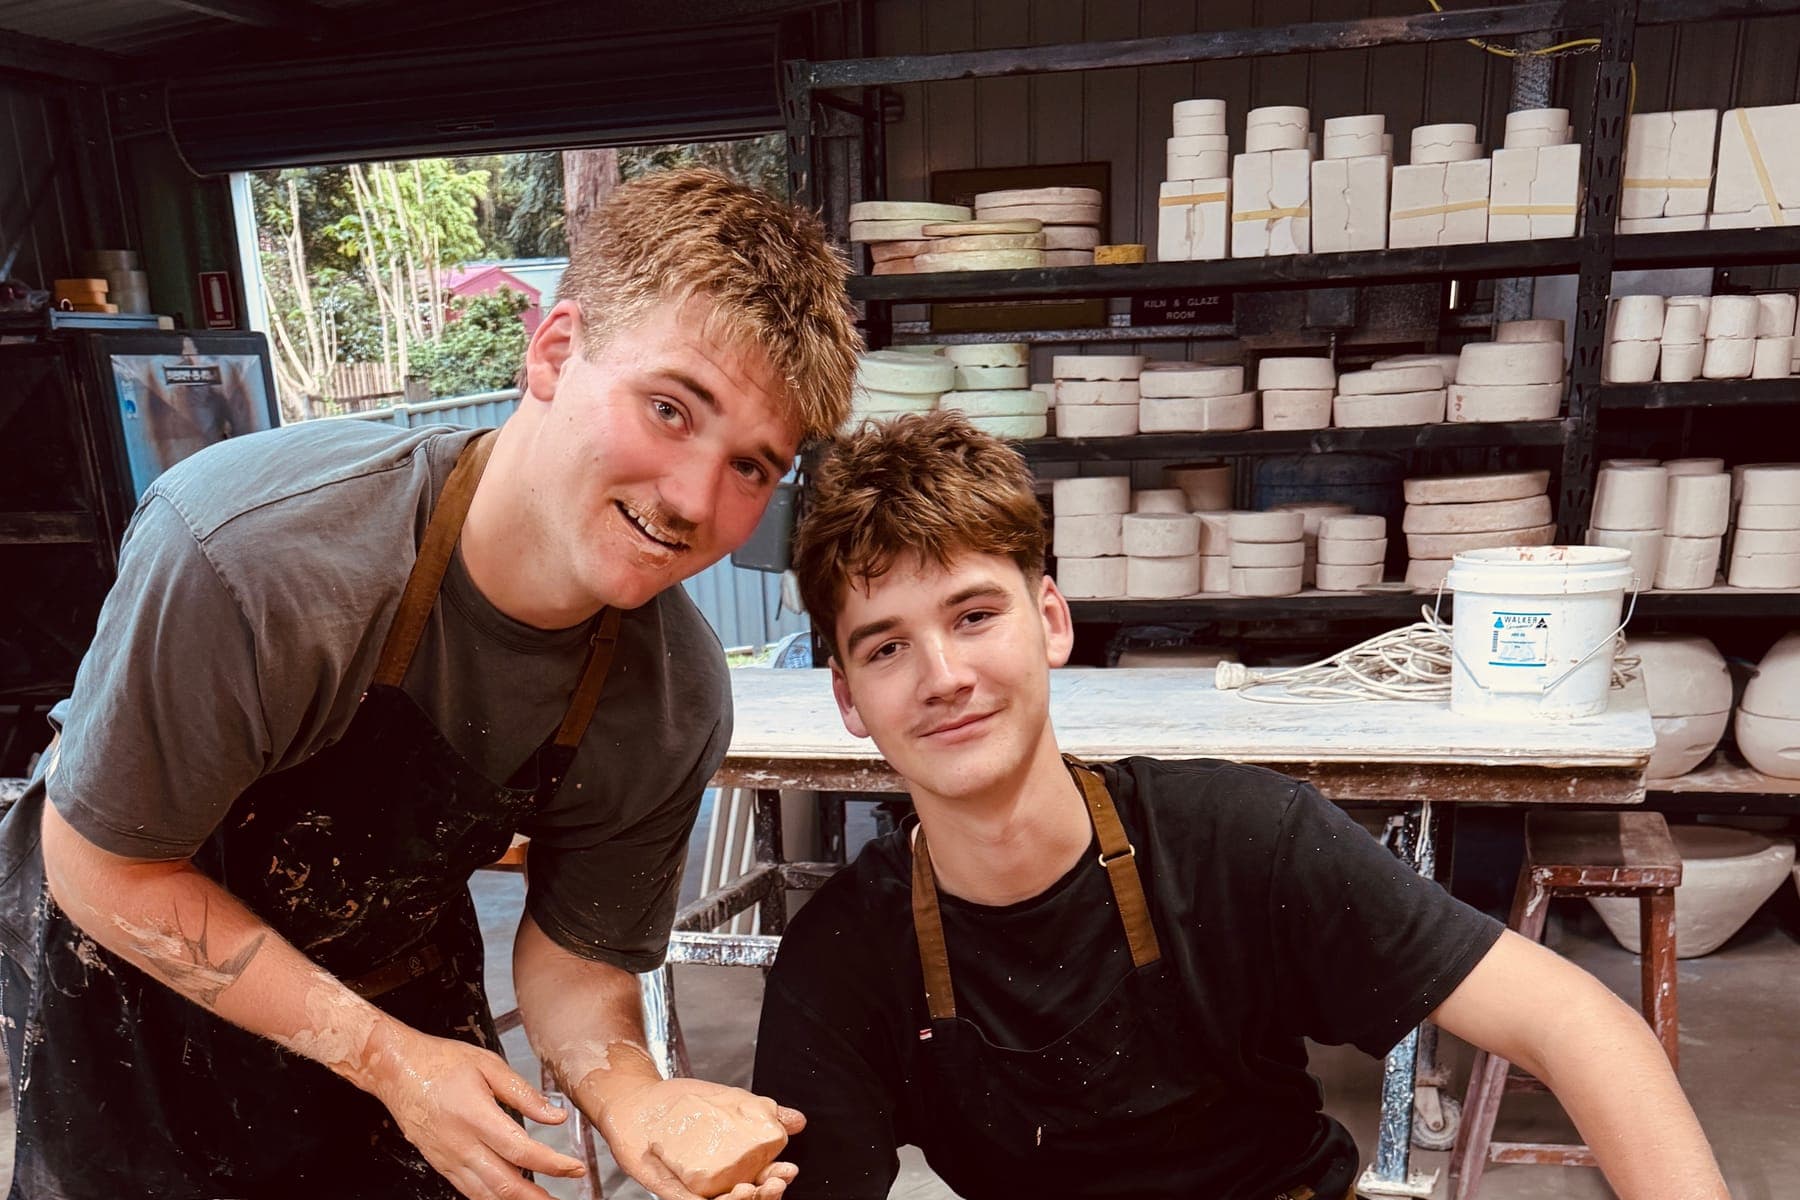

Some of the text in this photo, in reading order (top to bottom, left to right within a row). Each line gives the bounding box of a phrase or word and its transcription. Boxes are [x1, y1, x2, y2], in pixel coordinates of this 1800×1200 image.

[1143, 296, 1219, 308] KILN & GLAZE
[1166, 311, 1196, 319] ROOM
[1504, 616, 1537, 624] WALKER
